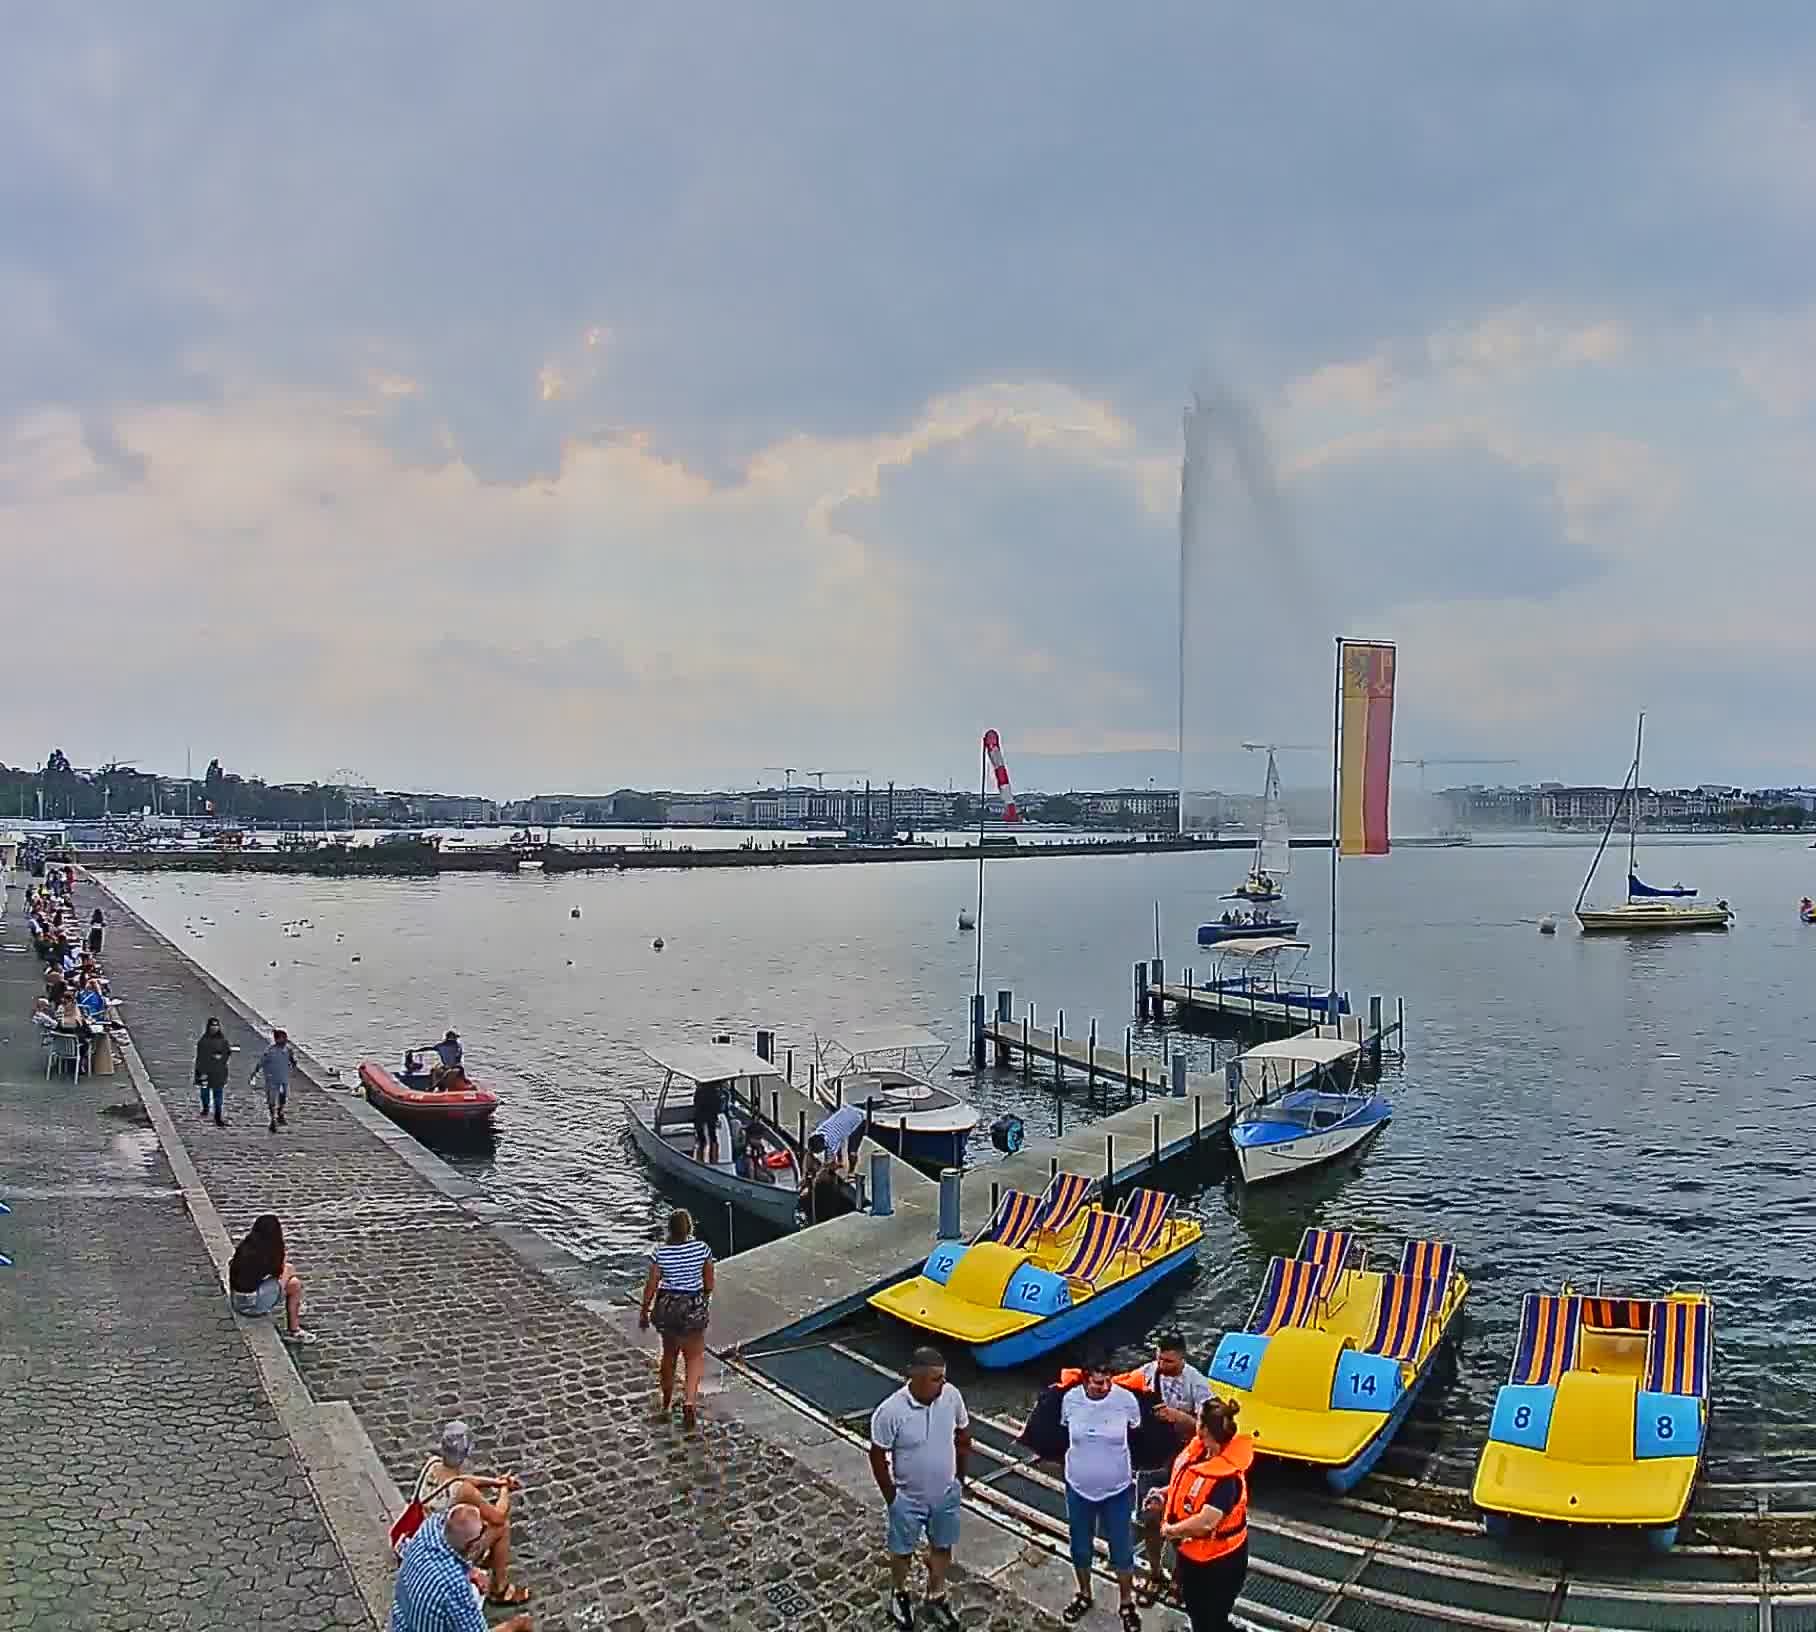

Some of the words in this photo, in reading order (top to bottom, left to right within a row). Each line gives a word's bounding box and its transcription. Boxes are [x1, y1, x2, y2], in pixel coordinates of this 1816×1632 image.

[937, 1255, 954, 1273] 12
[1020, 1281, 1042, 1302] 12
[1227, 1351, 1250, 1373] 14
[1350, 1372, 1377, 1396] 14
[1513, 1406, 1532, 1429] 8
[1656, 1415, 1674, 1439] 8
